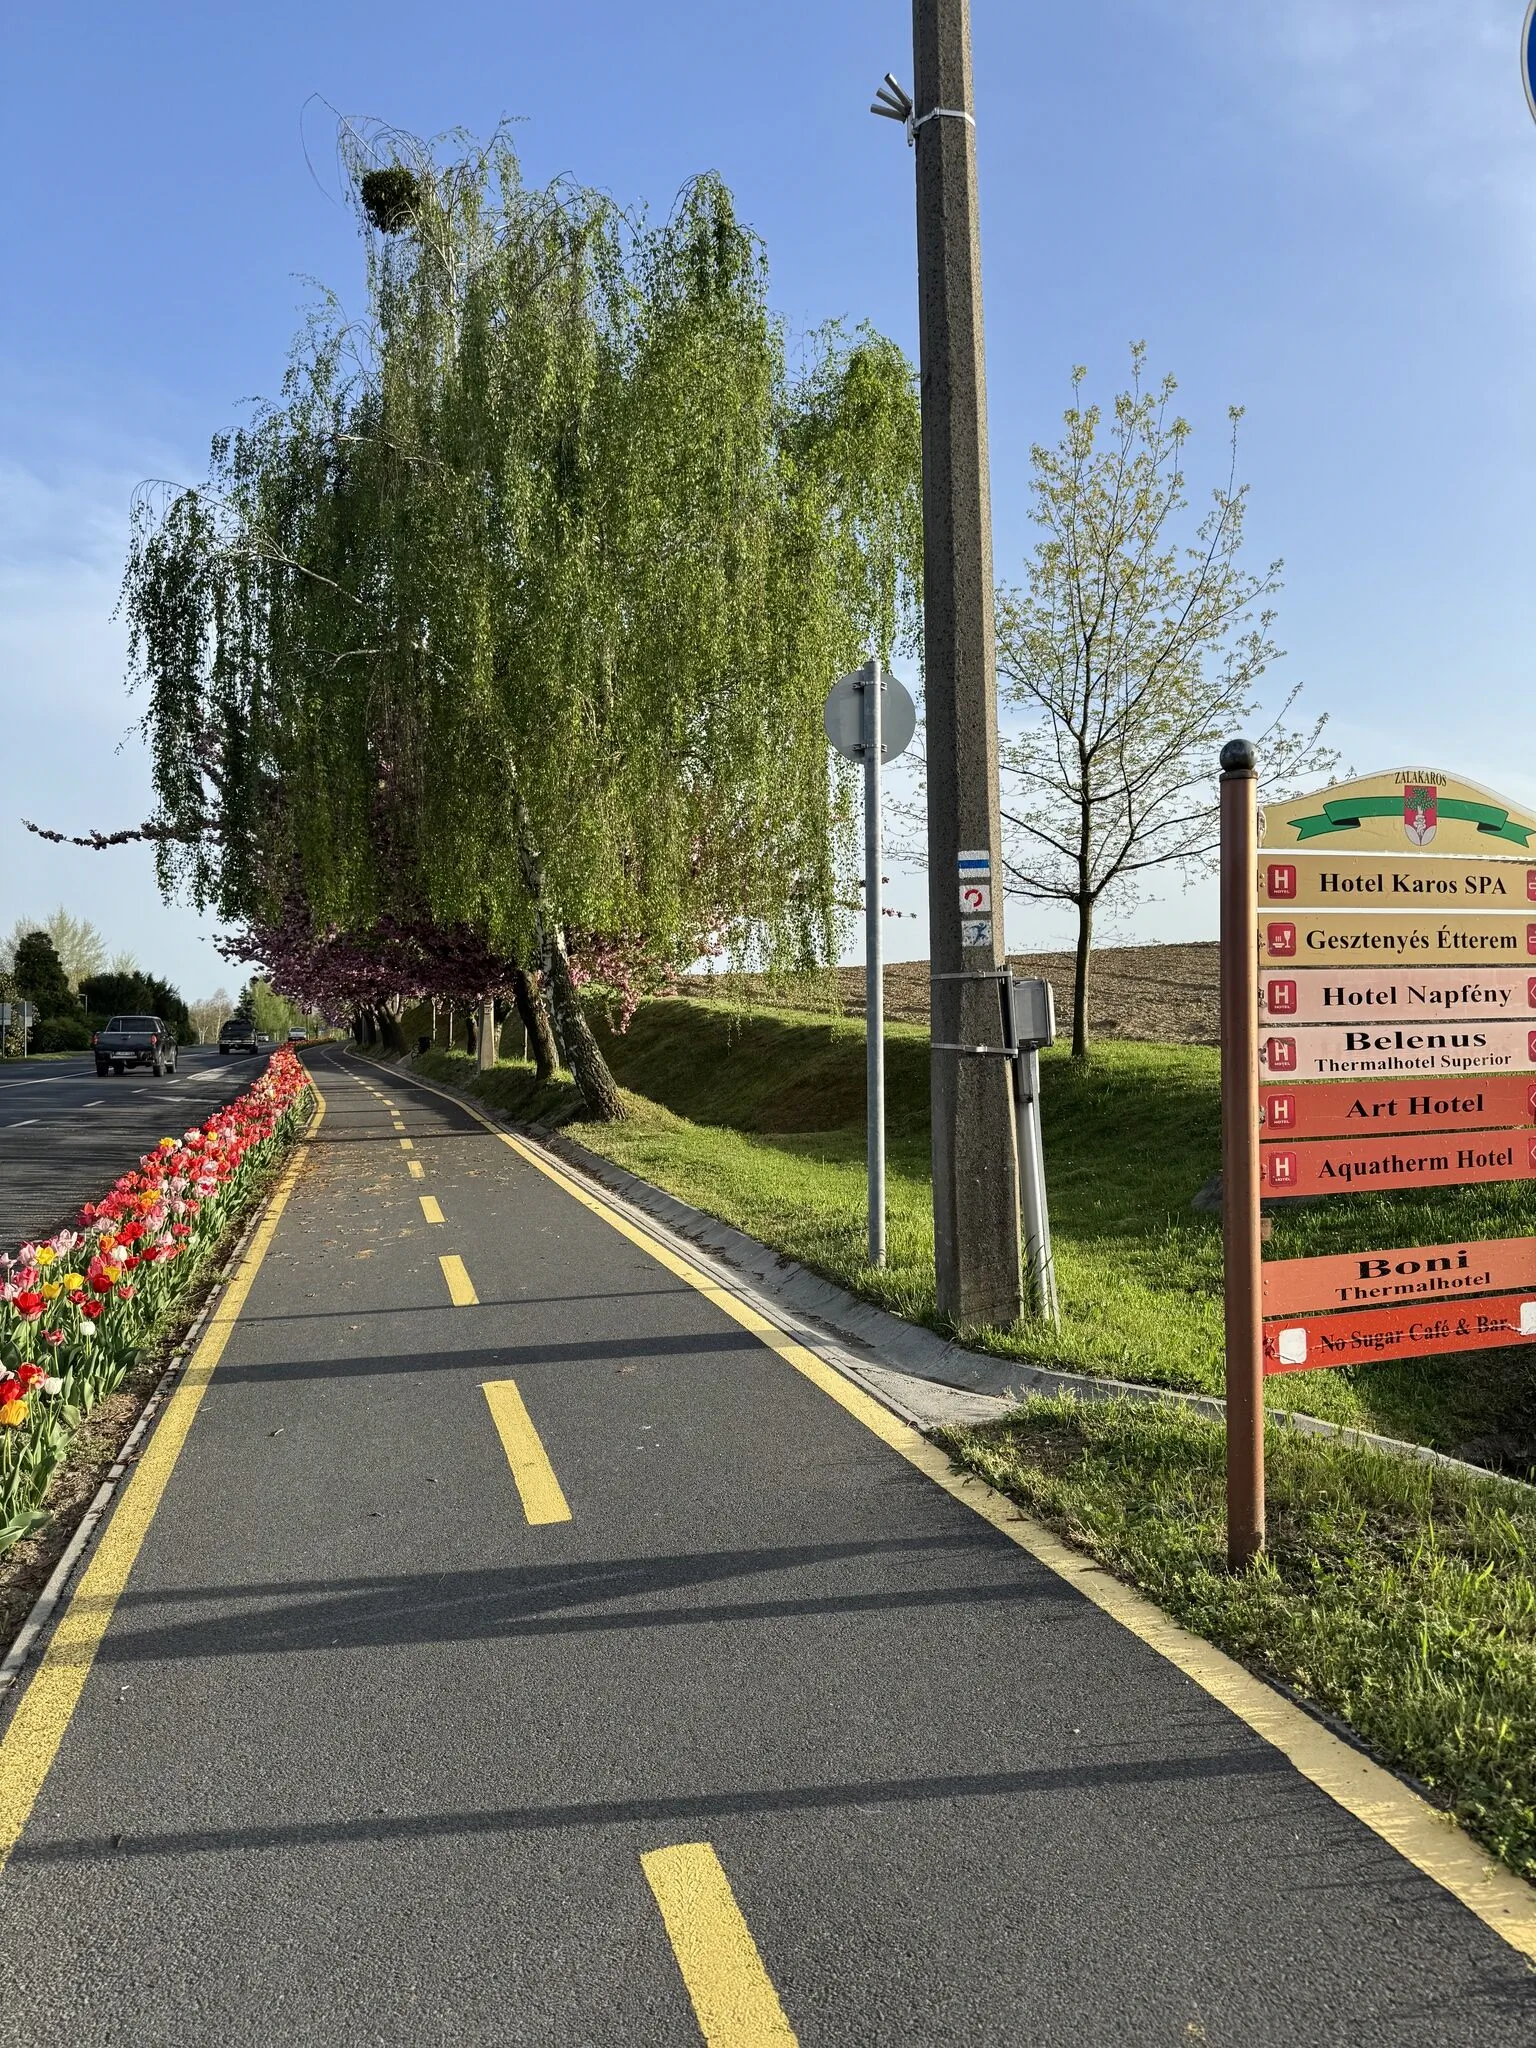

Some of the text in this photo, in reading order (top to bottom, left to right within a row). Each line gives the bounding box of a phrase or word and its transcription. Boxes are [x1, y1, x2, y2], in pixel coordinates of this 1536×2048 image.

[1394, 770, 1447, 786] ZALAKAROS
[1275, 870, 1288, 888] H
[1319, 873, 1508, 895] Hotel Karos SPA
[1306, 925, 1518, 954] Gesztenyés Étterem
[1275, 985, 1288, 1004] H
[1322, 984, 1512, 1009] Hotel Napfény
[1345, 1031, 1488, 1051] Belenus
[1275, 1042, 1288, 1062] H
[1314, 1053, 1512, 1073] Thermalhotel Superior
[1274, 1100, 1288, 1119] H
[1346, 1094, 1484, 1118] Art Hotel
[1276, 1158, 1289, 1176] H
[1318, 1148, 1514, 1182] Aquatherm Hotel
[1354, 1250, 1470, 1280] Boni
[1336, 1272, 1492, 1302] Thermalhotel
[1321, 1314, 1508, 1354] No Sugar Café & Bar
